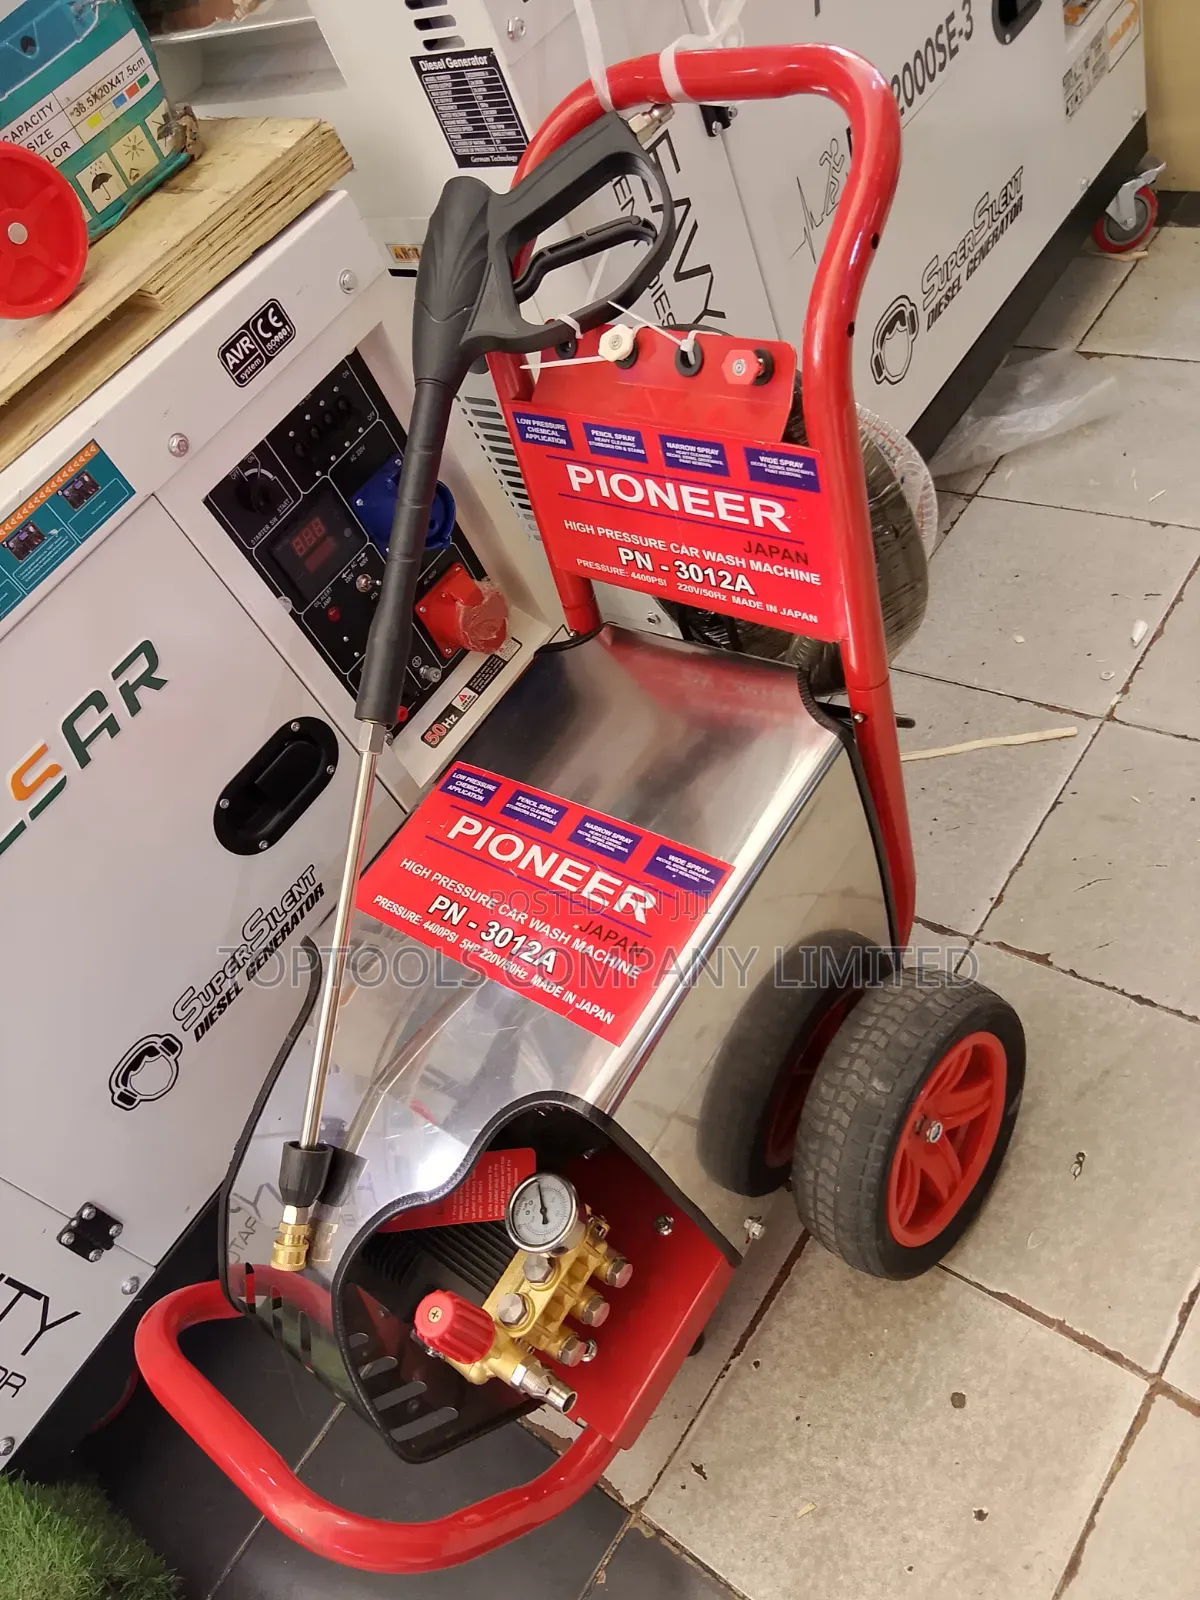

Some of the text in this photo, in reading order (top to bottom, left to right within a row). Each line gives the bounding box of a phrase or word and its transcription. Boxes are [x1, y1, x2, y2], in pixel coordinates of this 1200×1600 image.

[418, 55, 488, 72] Diesel Generator
[2, 101, 54, 144] CAPACITY
[26, 128, 54, 153] SIZE
[46, 140, 71, 164] LOR
[470, 154, 518, 163] German Technology
[646, 129, 726, 324] EAVY
[927, 194, 1023, 332] DIESEL GENERATOR
[225, 336, 255, 370] AVR
[240, 358, 262, 380] system
[516, 417, 567, 431] LOW PRESSURE
[527, 426, 560, 437] CHEMICAL
[591, 429, 636, 442] PENCIL SPRAY
[525, 433, 567, 445] APPLICATION
[666, 442, 720, 456] NARROW SPRAY
[759, 455, 804, 469] WIDE SPRAY
[230, 469, 240, 480] OFF
[277, 498, 290, 514] START
[565, 464, 791, 533] PIONEER
[250, 516, 278, 545] STARTER SW
[563, 519, 822, 586] HIGH PRESSURE CAR WASH MACHINE
[743, 541, 809, 566] JAPAN
[617, 546, 655, 572] PN
[673, 560, 757, 596] 3012A
[320, 586, 333, 601] ALERT
[576, 558, 818, 624] PRESSURE: 4400PSI 220V/50Hz MADE IN JAPAN
[0, 639, 169, 856] SAR
[447, 785, 485, 802] APPLICATION
[452, 772, 498, 792] LOW PRESSURE
[455, 780, 484, 795] CHEMICAL
[517, 795, 559, 815] PENCIL SPRAY
[584, 822, 634, 845] NARROW SPRAY
[446, 815, 657, 925] PIONEER
[668, 854, 710, 876] WIDE SPRAY
[399, 857, 643, 980] HIGH PRESSURE CAR WASH MACHINE
[427, 894, 469, 927] PN
[479, 919, 558, 975] 3012A
[579, 920, 648, 958] JAPAN
[194, 882, 325, 1042] DIESEL GENERATOR
[373, 894, 615, 1025] PRESSURE: 4400PSI 5HP 220V/50Hz MADE IN JAPAN
